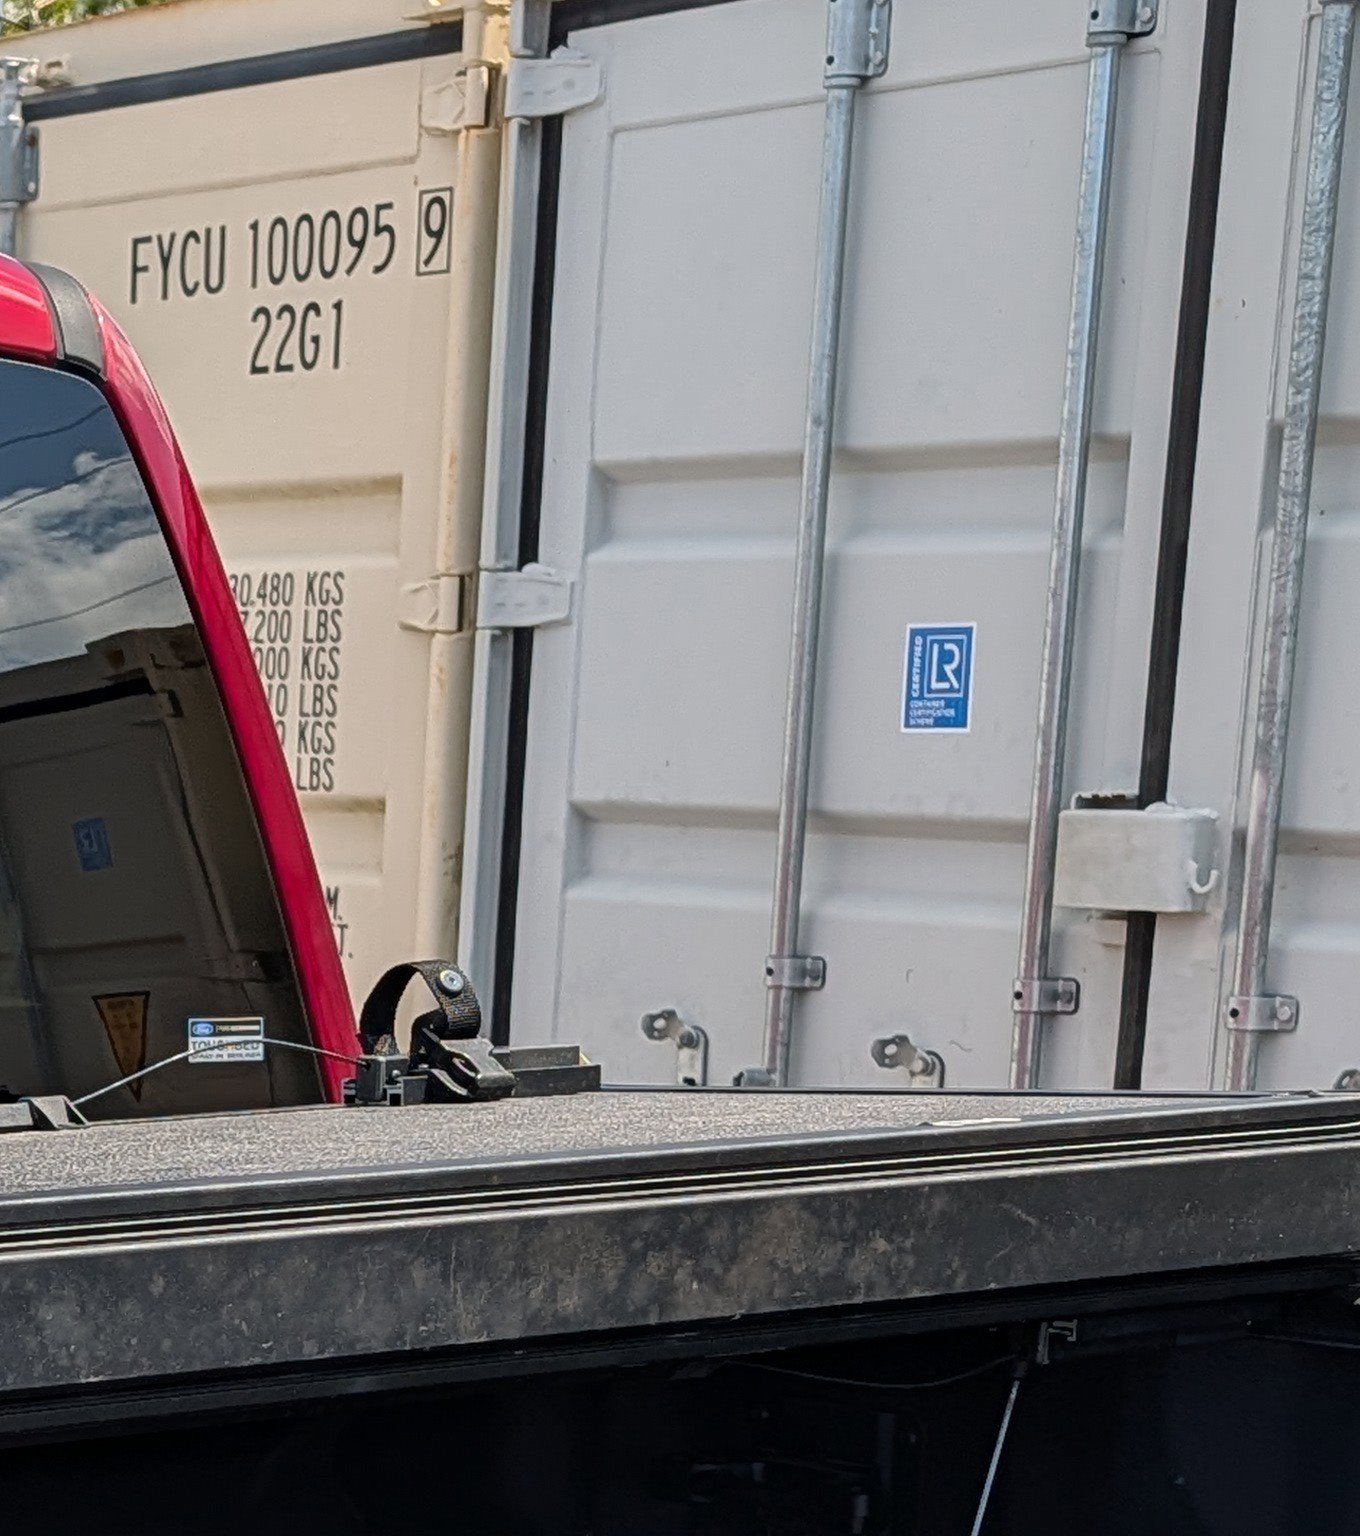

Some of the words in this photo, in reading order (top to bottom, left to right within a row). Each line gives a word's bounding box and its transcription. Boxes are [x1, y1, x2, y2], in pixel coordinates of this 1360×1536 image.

[130, 224, 226, 304] FYCU
[249, 202, 396, 289] 100095
[423, 196, 447, 267] 9
[250, 300, 343, 375] 22G1
[304, 570, 345, 607] KGS
[303, 609, 342, 644] LBS
[301, 646, 341, 681] KGS
[931, 642, 961, 689] LR
[299, 683, 338, 717] LBS
[297, 720, 336, 755] KGS
[296, 756, 334, 792] LBS
